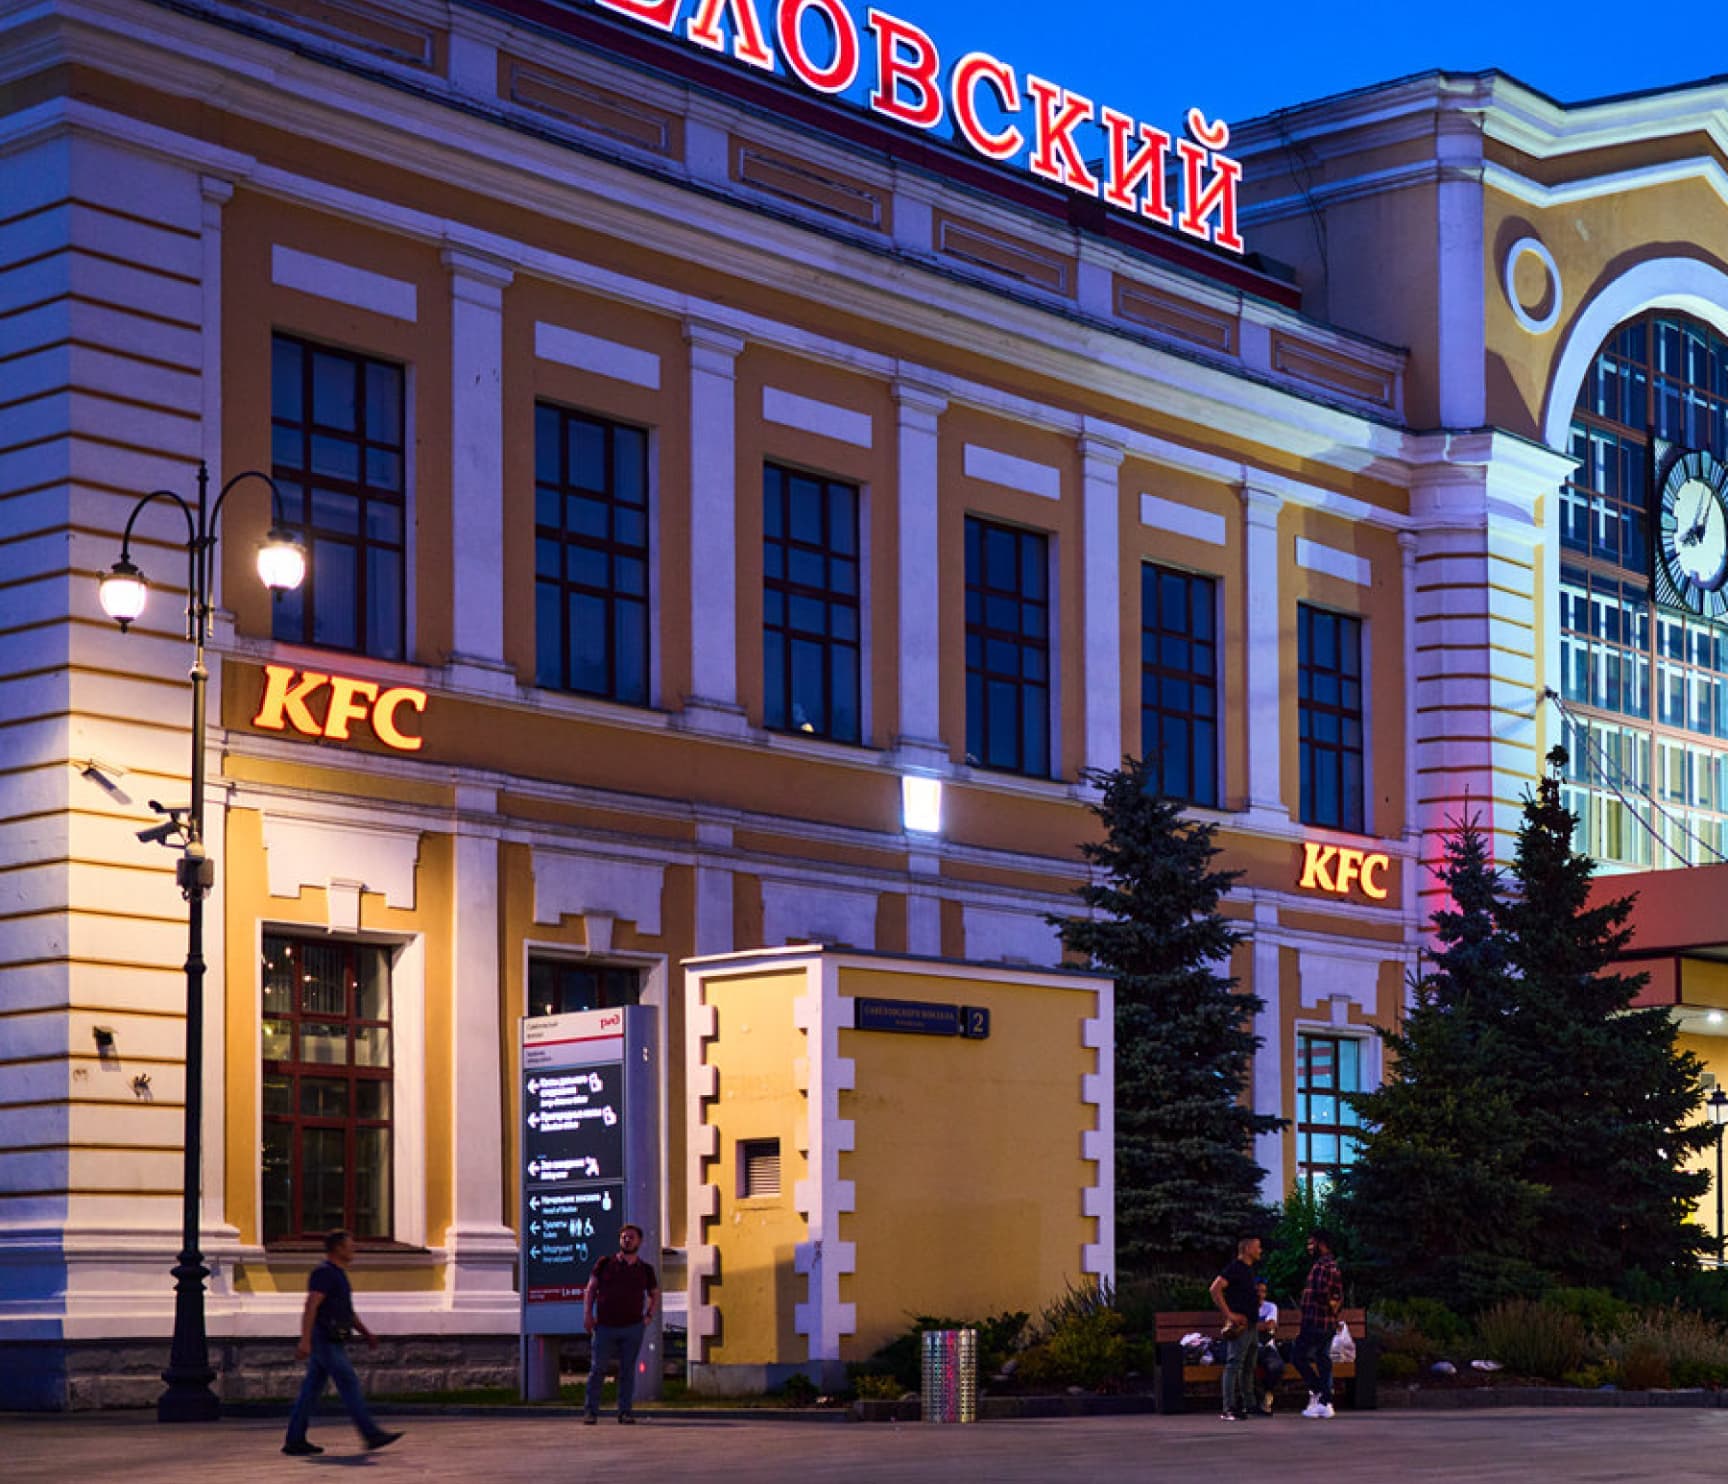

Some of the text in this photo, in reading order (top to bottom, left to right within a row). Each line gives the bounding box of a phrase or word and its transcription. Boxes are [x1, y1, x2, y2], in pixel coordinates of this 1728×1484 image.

[595, 0, 1245, 254] ЛОВСКИЙ
[253, 664, 428, 751] KFC
[1299, 842, 1389, 899] KFC
[972, 1012, 984, 1033] 2
